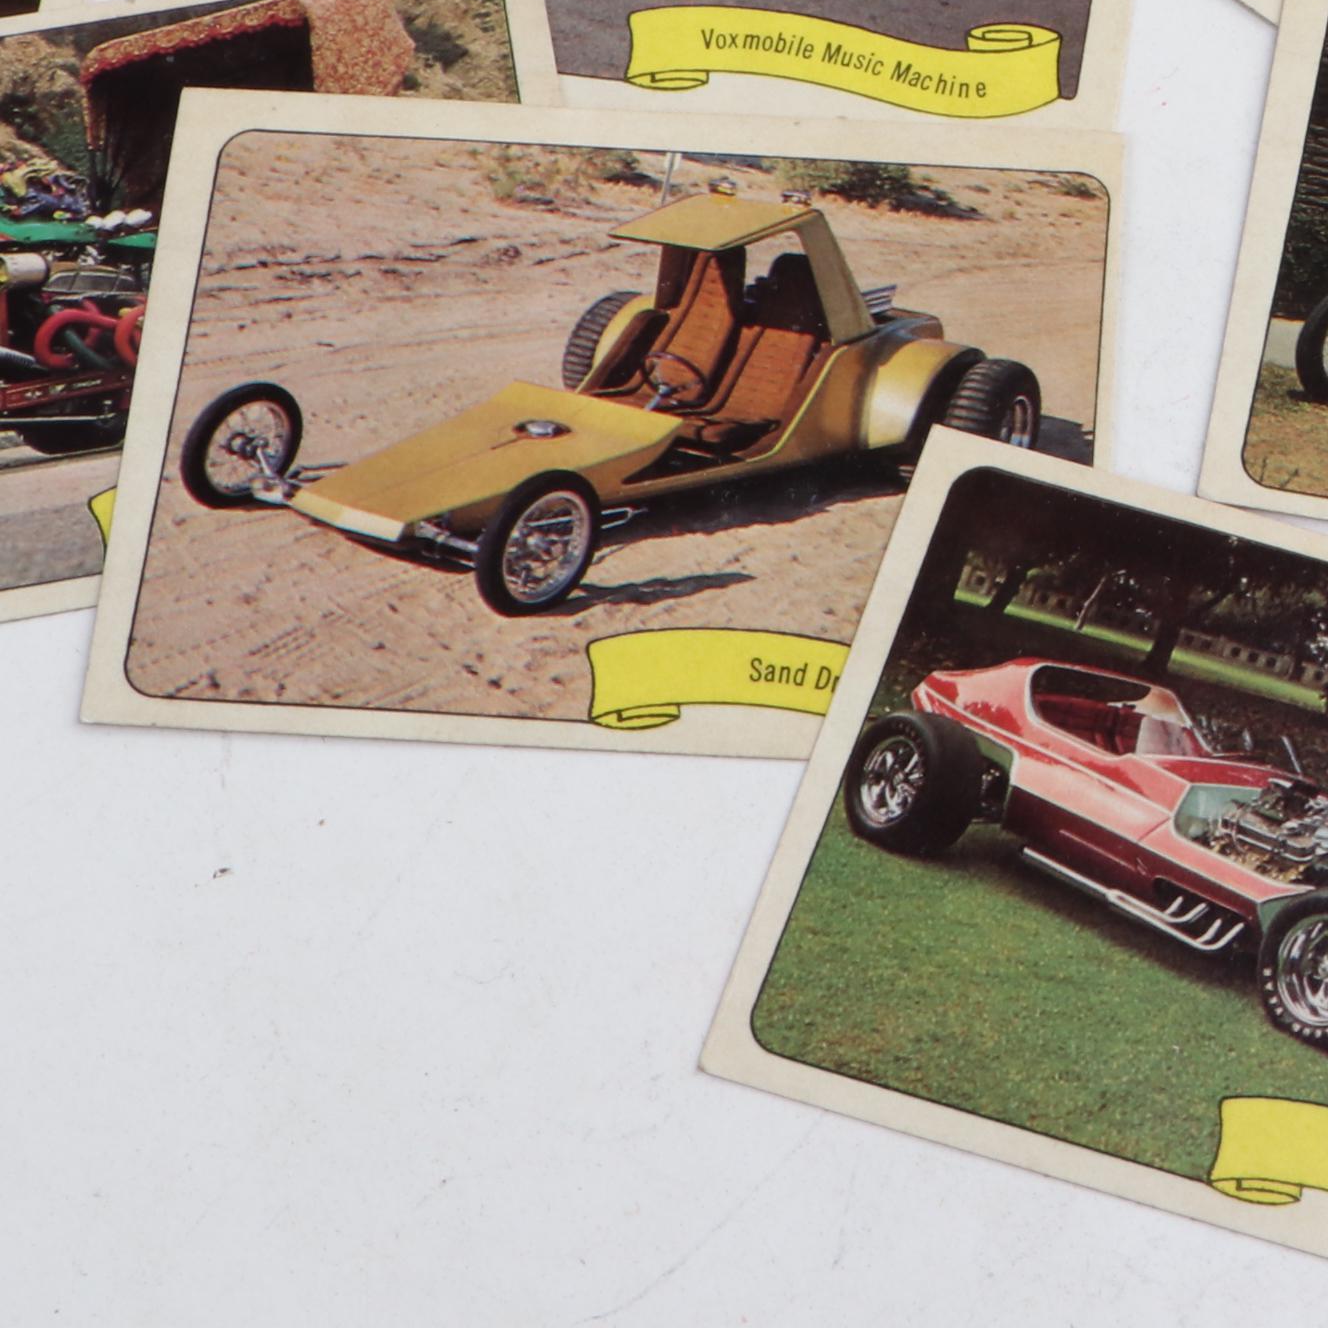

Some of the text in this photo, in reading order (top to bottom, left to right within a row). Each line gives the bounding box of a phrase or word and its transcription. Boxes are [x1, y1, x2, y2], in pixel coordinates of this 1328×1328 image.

[700, 27, 988, 99] Voxmobile Music Machine
[748, 657, 809, 687] Sand
